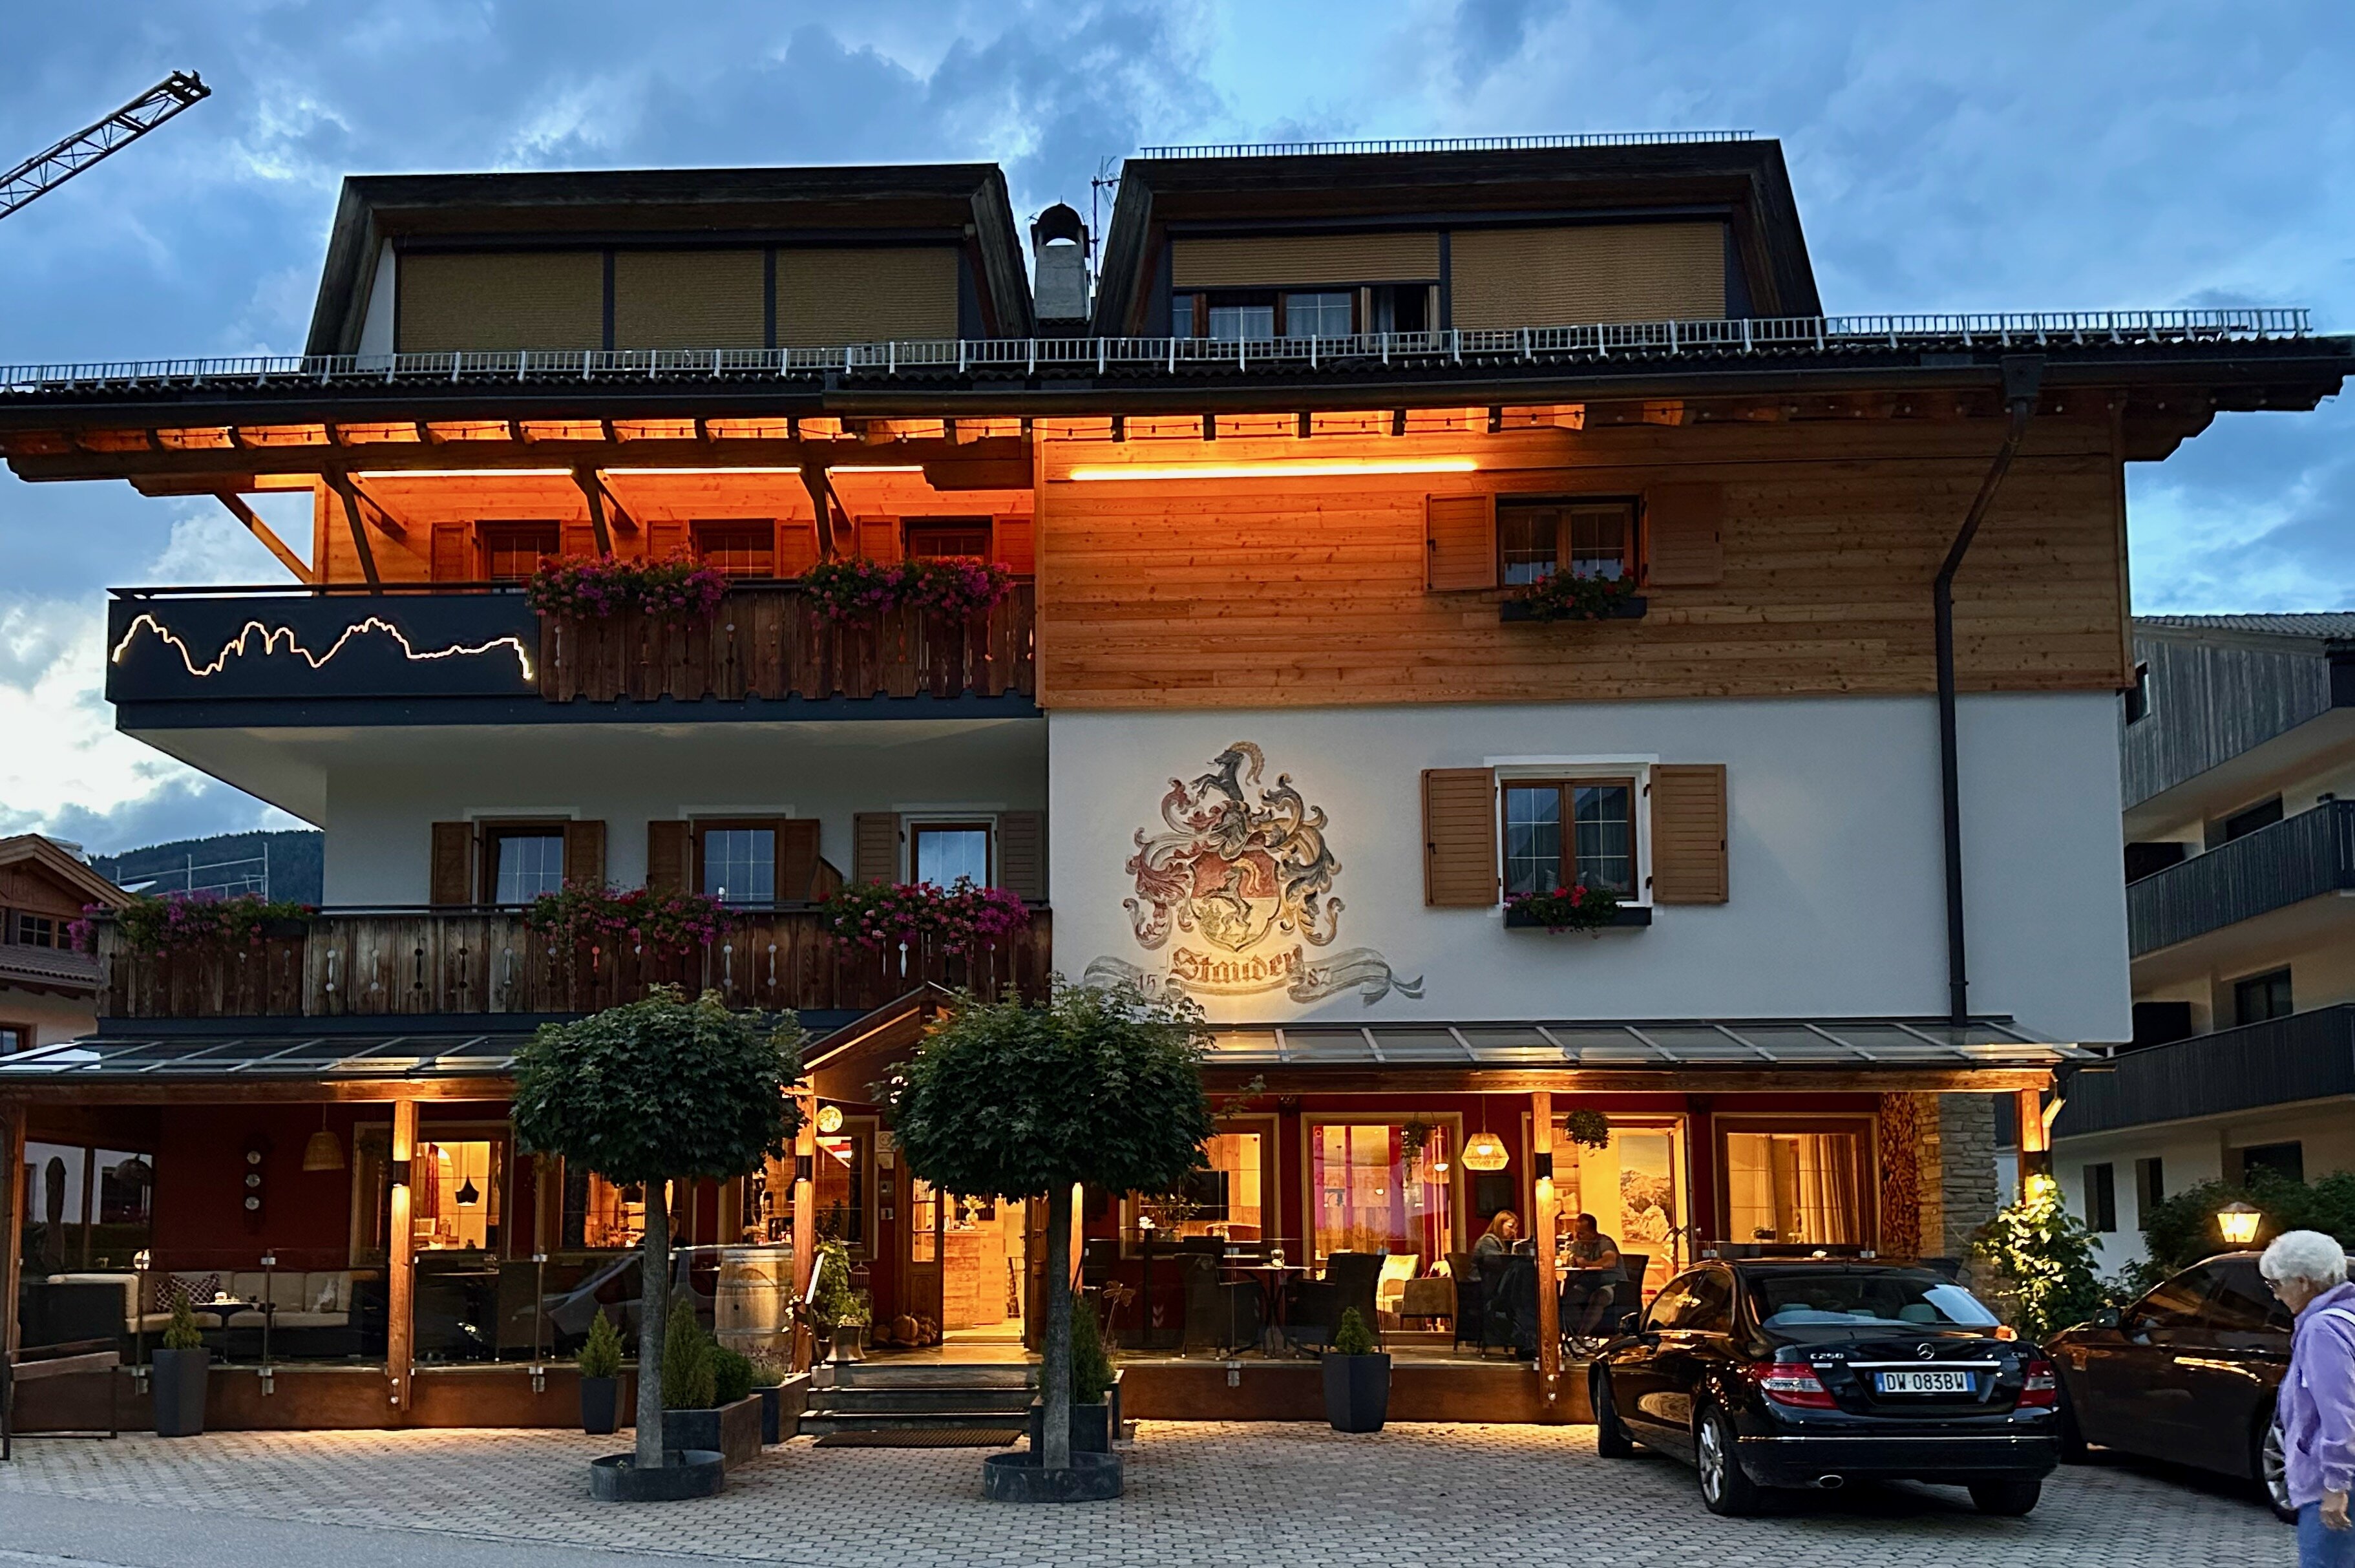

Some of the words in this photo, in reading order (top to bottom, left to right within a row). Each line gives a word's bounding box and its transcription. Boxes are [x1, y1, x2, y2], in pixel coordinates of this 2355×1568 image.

[1137, 973, 1157, 995] 15
[1169, 946, 1302, 982] Stauder
[1886, 1373, 1906, 1390] DW
[1913, 1373, 1964, 1390] 083BW
